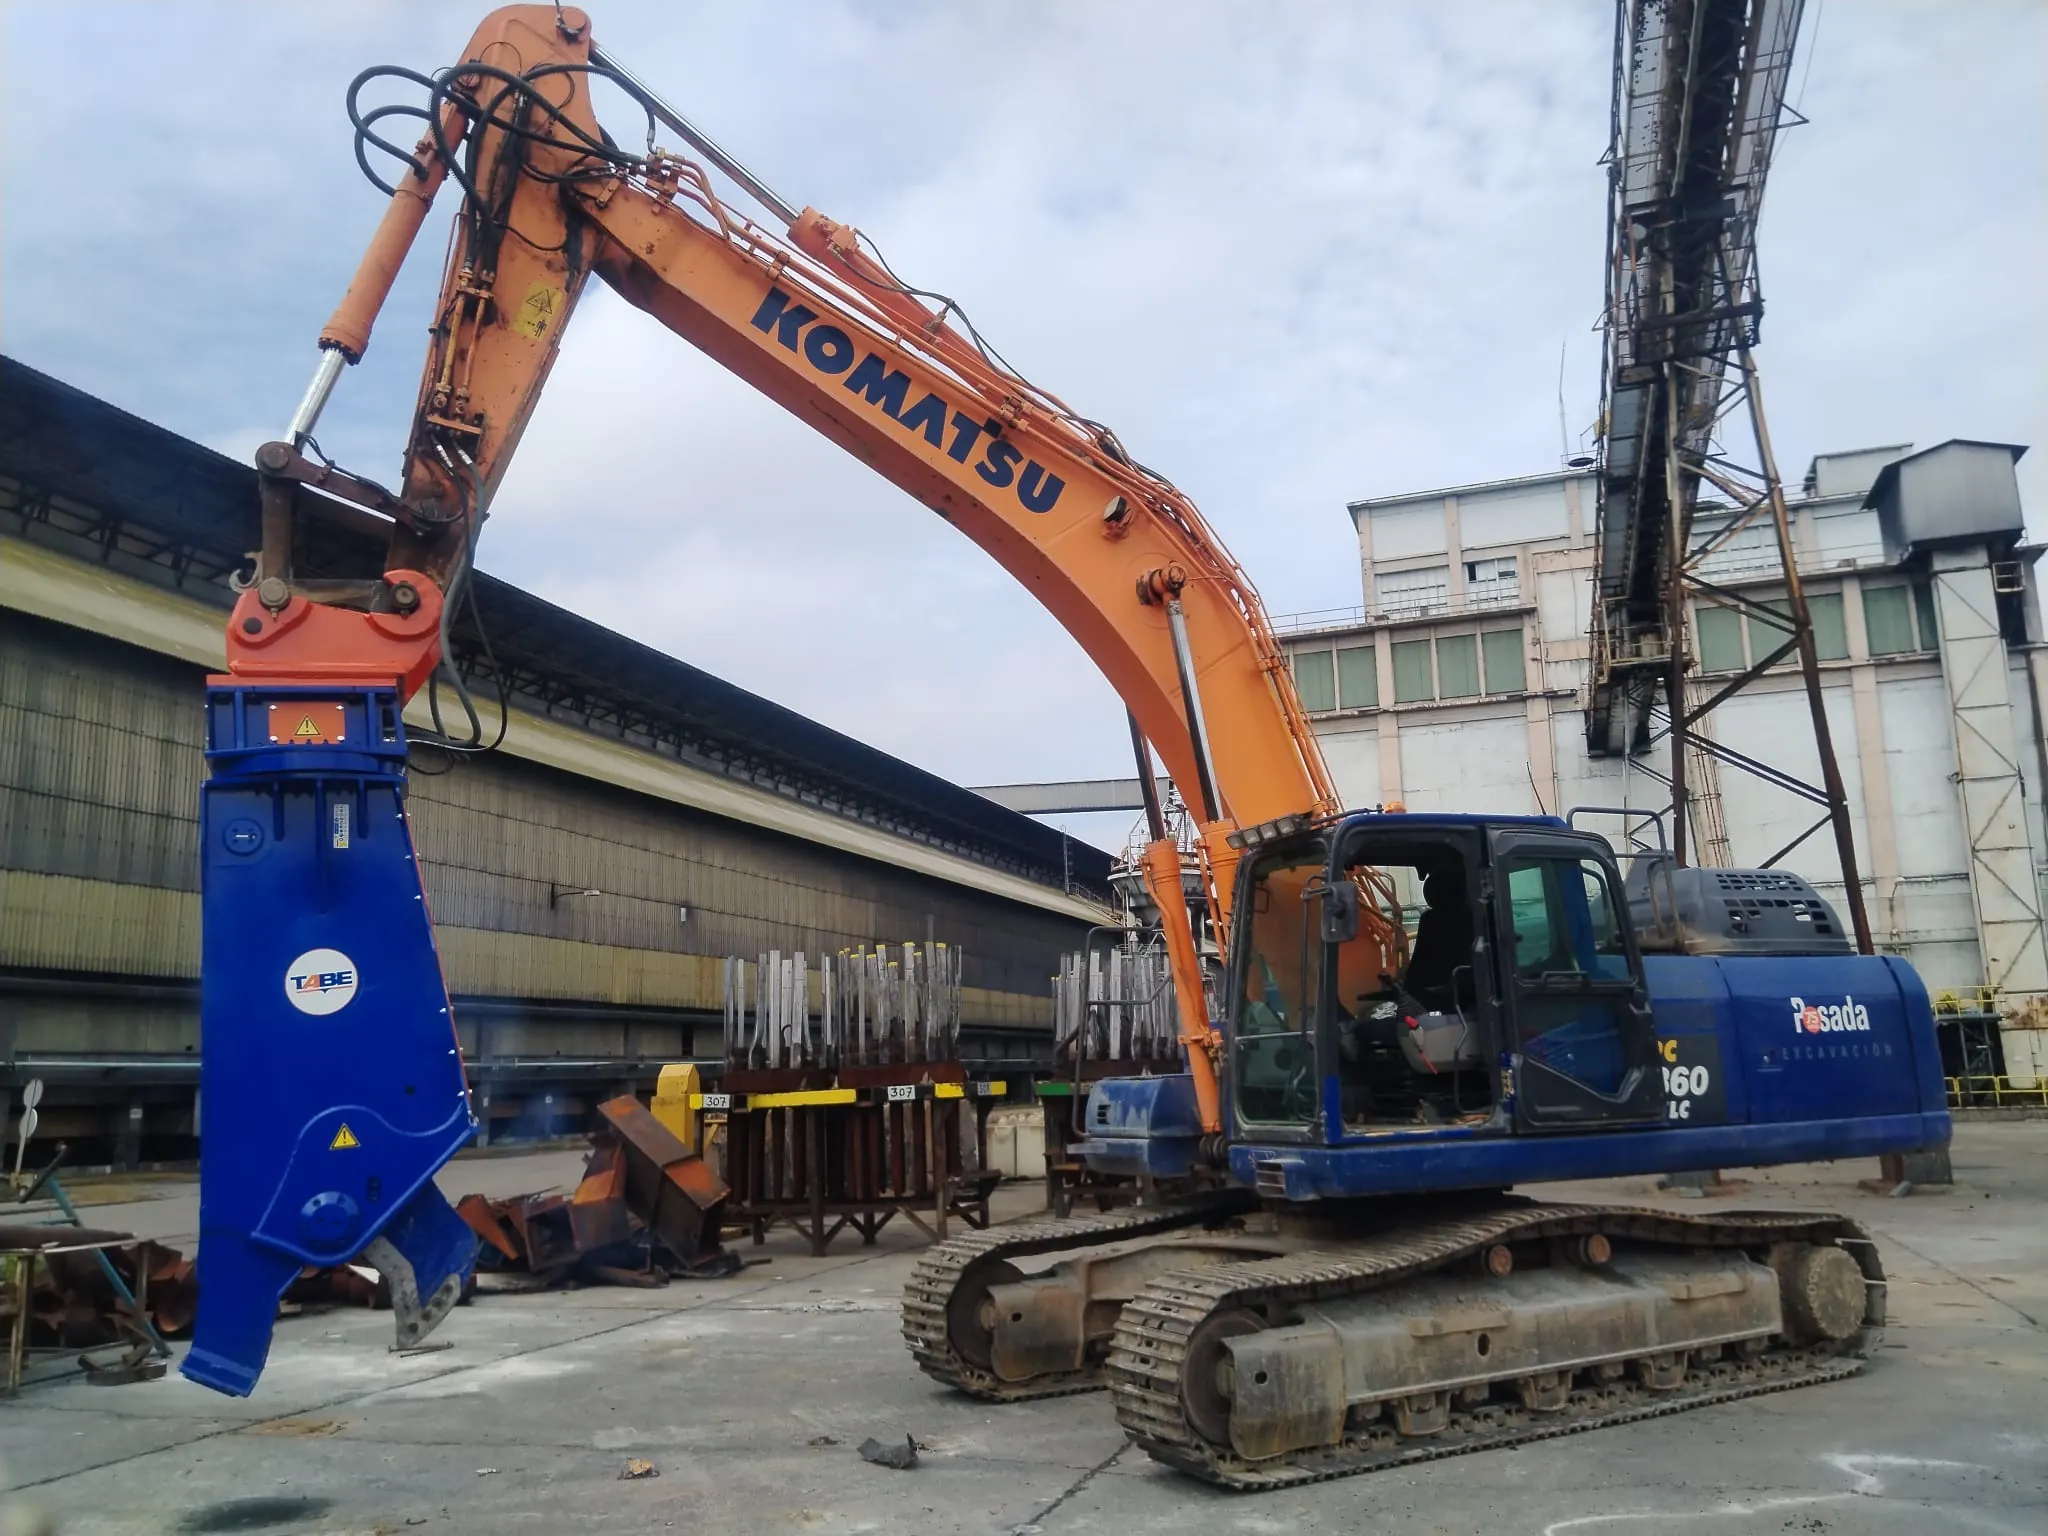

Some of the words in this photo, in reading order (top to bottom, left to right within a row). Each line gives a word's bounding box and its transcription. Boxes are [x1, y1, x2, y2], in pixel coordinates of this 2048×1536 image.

[751, 286, 1066, 514] KOMATSU
[290, 971, 353, 990] TABE
[890, 1086, 912, 1098] 307
[706, 1096, 726, 1107] 307
